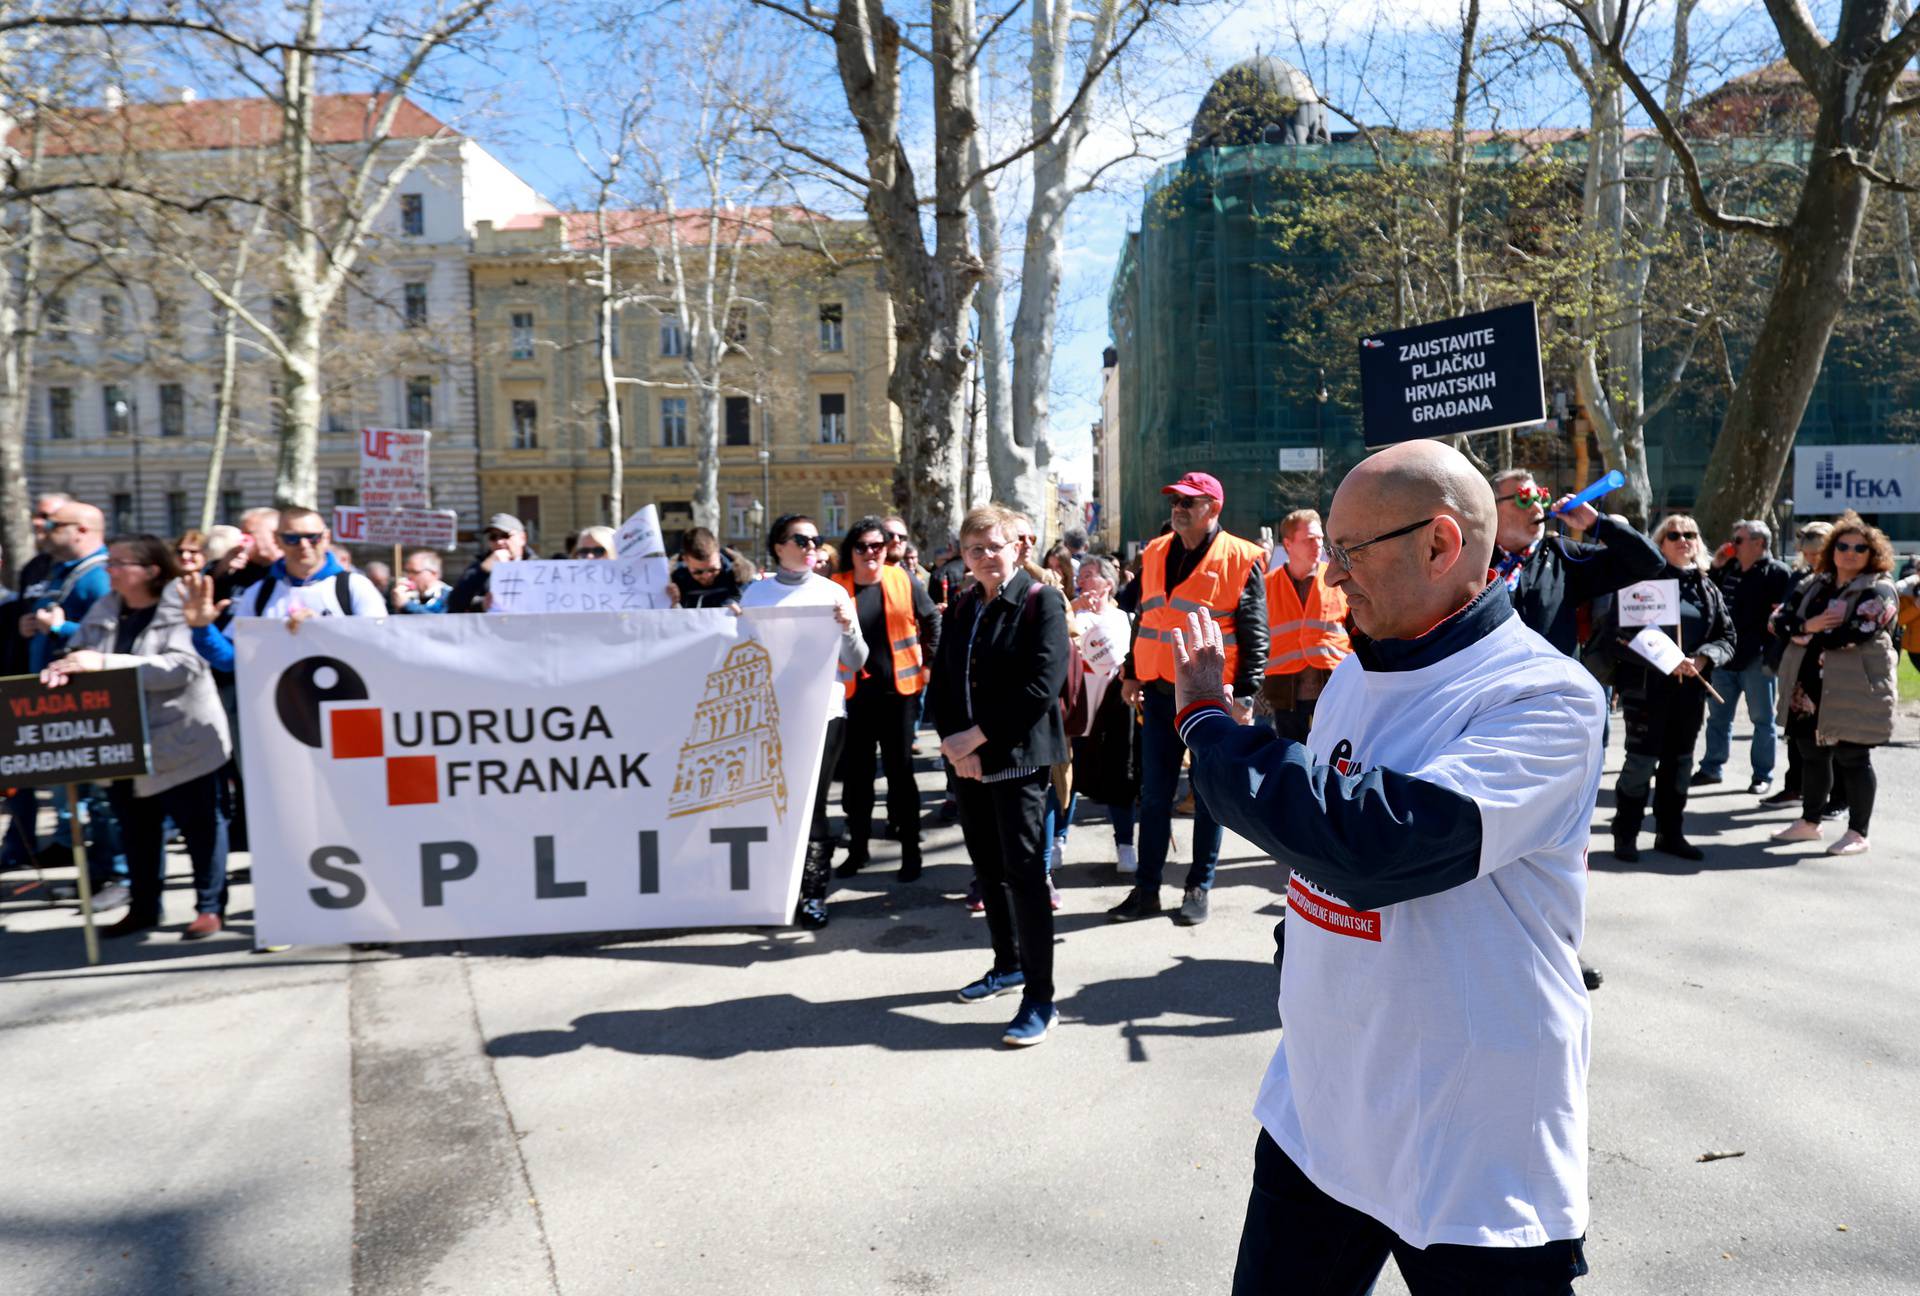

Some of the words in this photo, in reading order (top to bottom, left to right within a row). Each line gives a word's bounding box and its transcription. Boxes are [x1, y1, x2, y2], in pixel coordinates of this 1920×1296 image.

[1399, 328, 1495, 362] ZAUSTAVITE
[1411, 351, 1486, 380] PLJAČKU
[1405, 371, 1497, 403] HRVATSKIH
[1411, 394, 1493, 423] GRAĐANA
[533, 563, 651, 586] ZATRUBI
[10, 692, 78, 718] VLADA
[81, 688, 112, 710] RH
[14, 723, 40, 746] JE
[42, 717, 115, 743] IZDALA
[392, 705, 614, 747] UDRUGA
[447, 752, 652, 797] FRANAK
[1329, 909, 1374, 933] HRVATSKE
